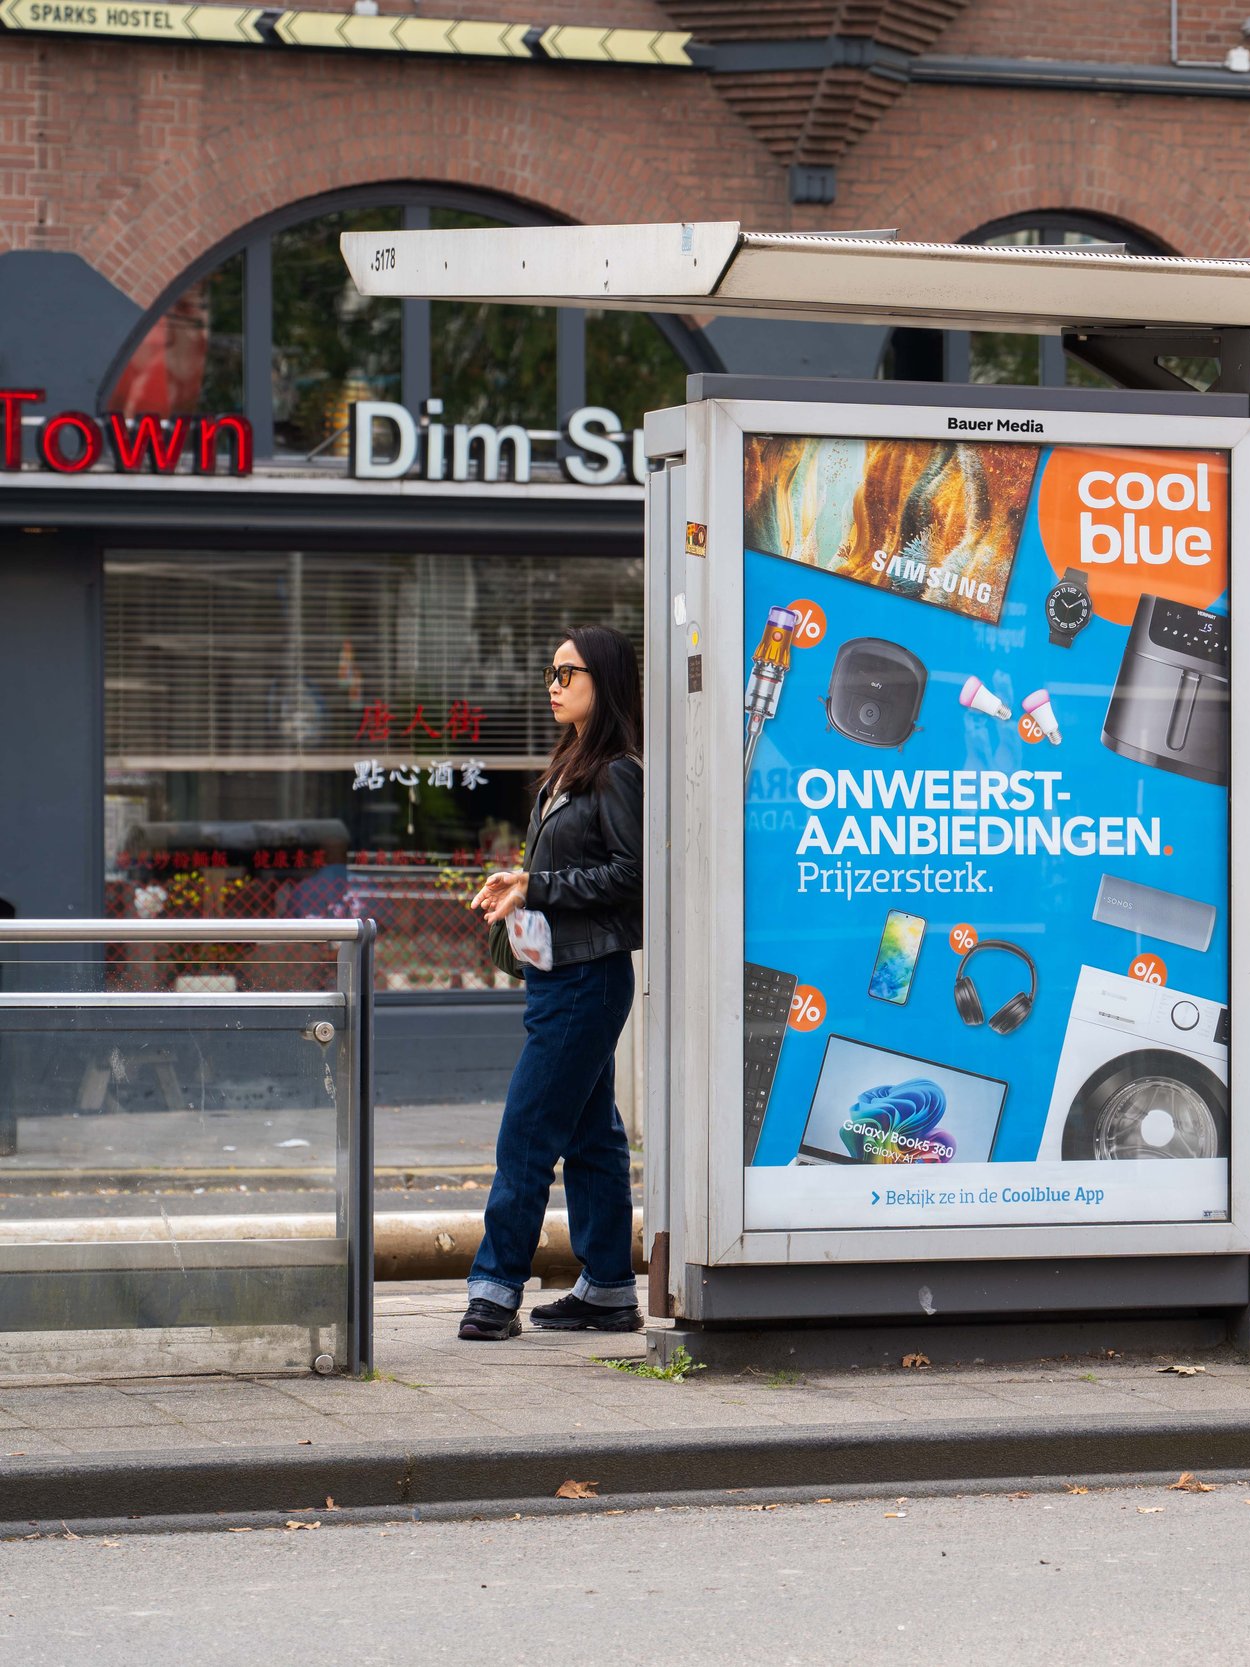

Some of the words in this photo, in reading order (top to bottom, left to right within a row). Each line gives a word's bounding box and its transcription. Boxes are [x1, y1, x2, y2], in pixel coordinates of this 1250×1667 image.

[30, 4, 97, 25] SPARKS
[106, 9, 173, 30] HOSTEL
[375, 247, 396, 271] 5178
[0, 388, 253, 477] Town
[350, 398, 531, 482] Dim
[563, 406, 647, 485] S
[947, 417, 993, 431] Bauer
[997, 419, 1044, 433] Media
[1078, 463, 1211, 512] cool
[1080, 511, 1212, 566] blue
[871, 550, 992, 604] SAMSUNG
[355, 699, 489, 743] 唐人街
[352, 758, 490, 791] 點心酒家
[797, 768, 1071, 811] ONWEERST-
[796, 815, 1173, 857] AANBIEDINGEN.
[797, 861, 994, 900] Prijzersterk.
[1107, 896, 1134, 910] SONOS
[842, 1119, 890, 1144] Galaxy
[890, 1131, 931, 1152] Book5
[931, 1145, 954, 1159] 360
[863, 1143, 902, 1163] Galaxy
[885, 1190, 935, 1209] Bekijk
[939, 1191, 956, 1205] ze
[959, 1189, 975, 1204] in
[978, 1188, 998, 1204] de
[1001, 1187, 1071, 1203] Coolblue
[1074, 1186, 1104, 1204] App
